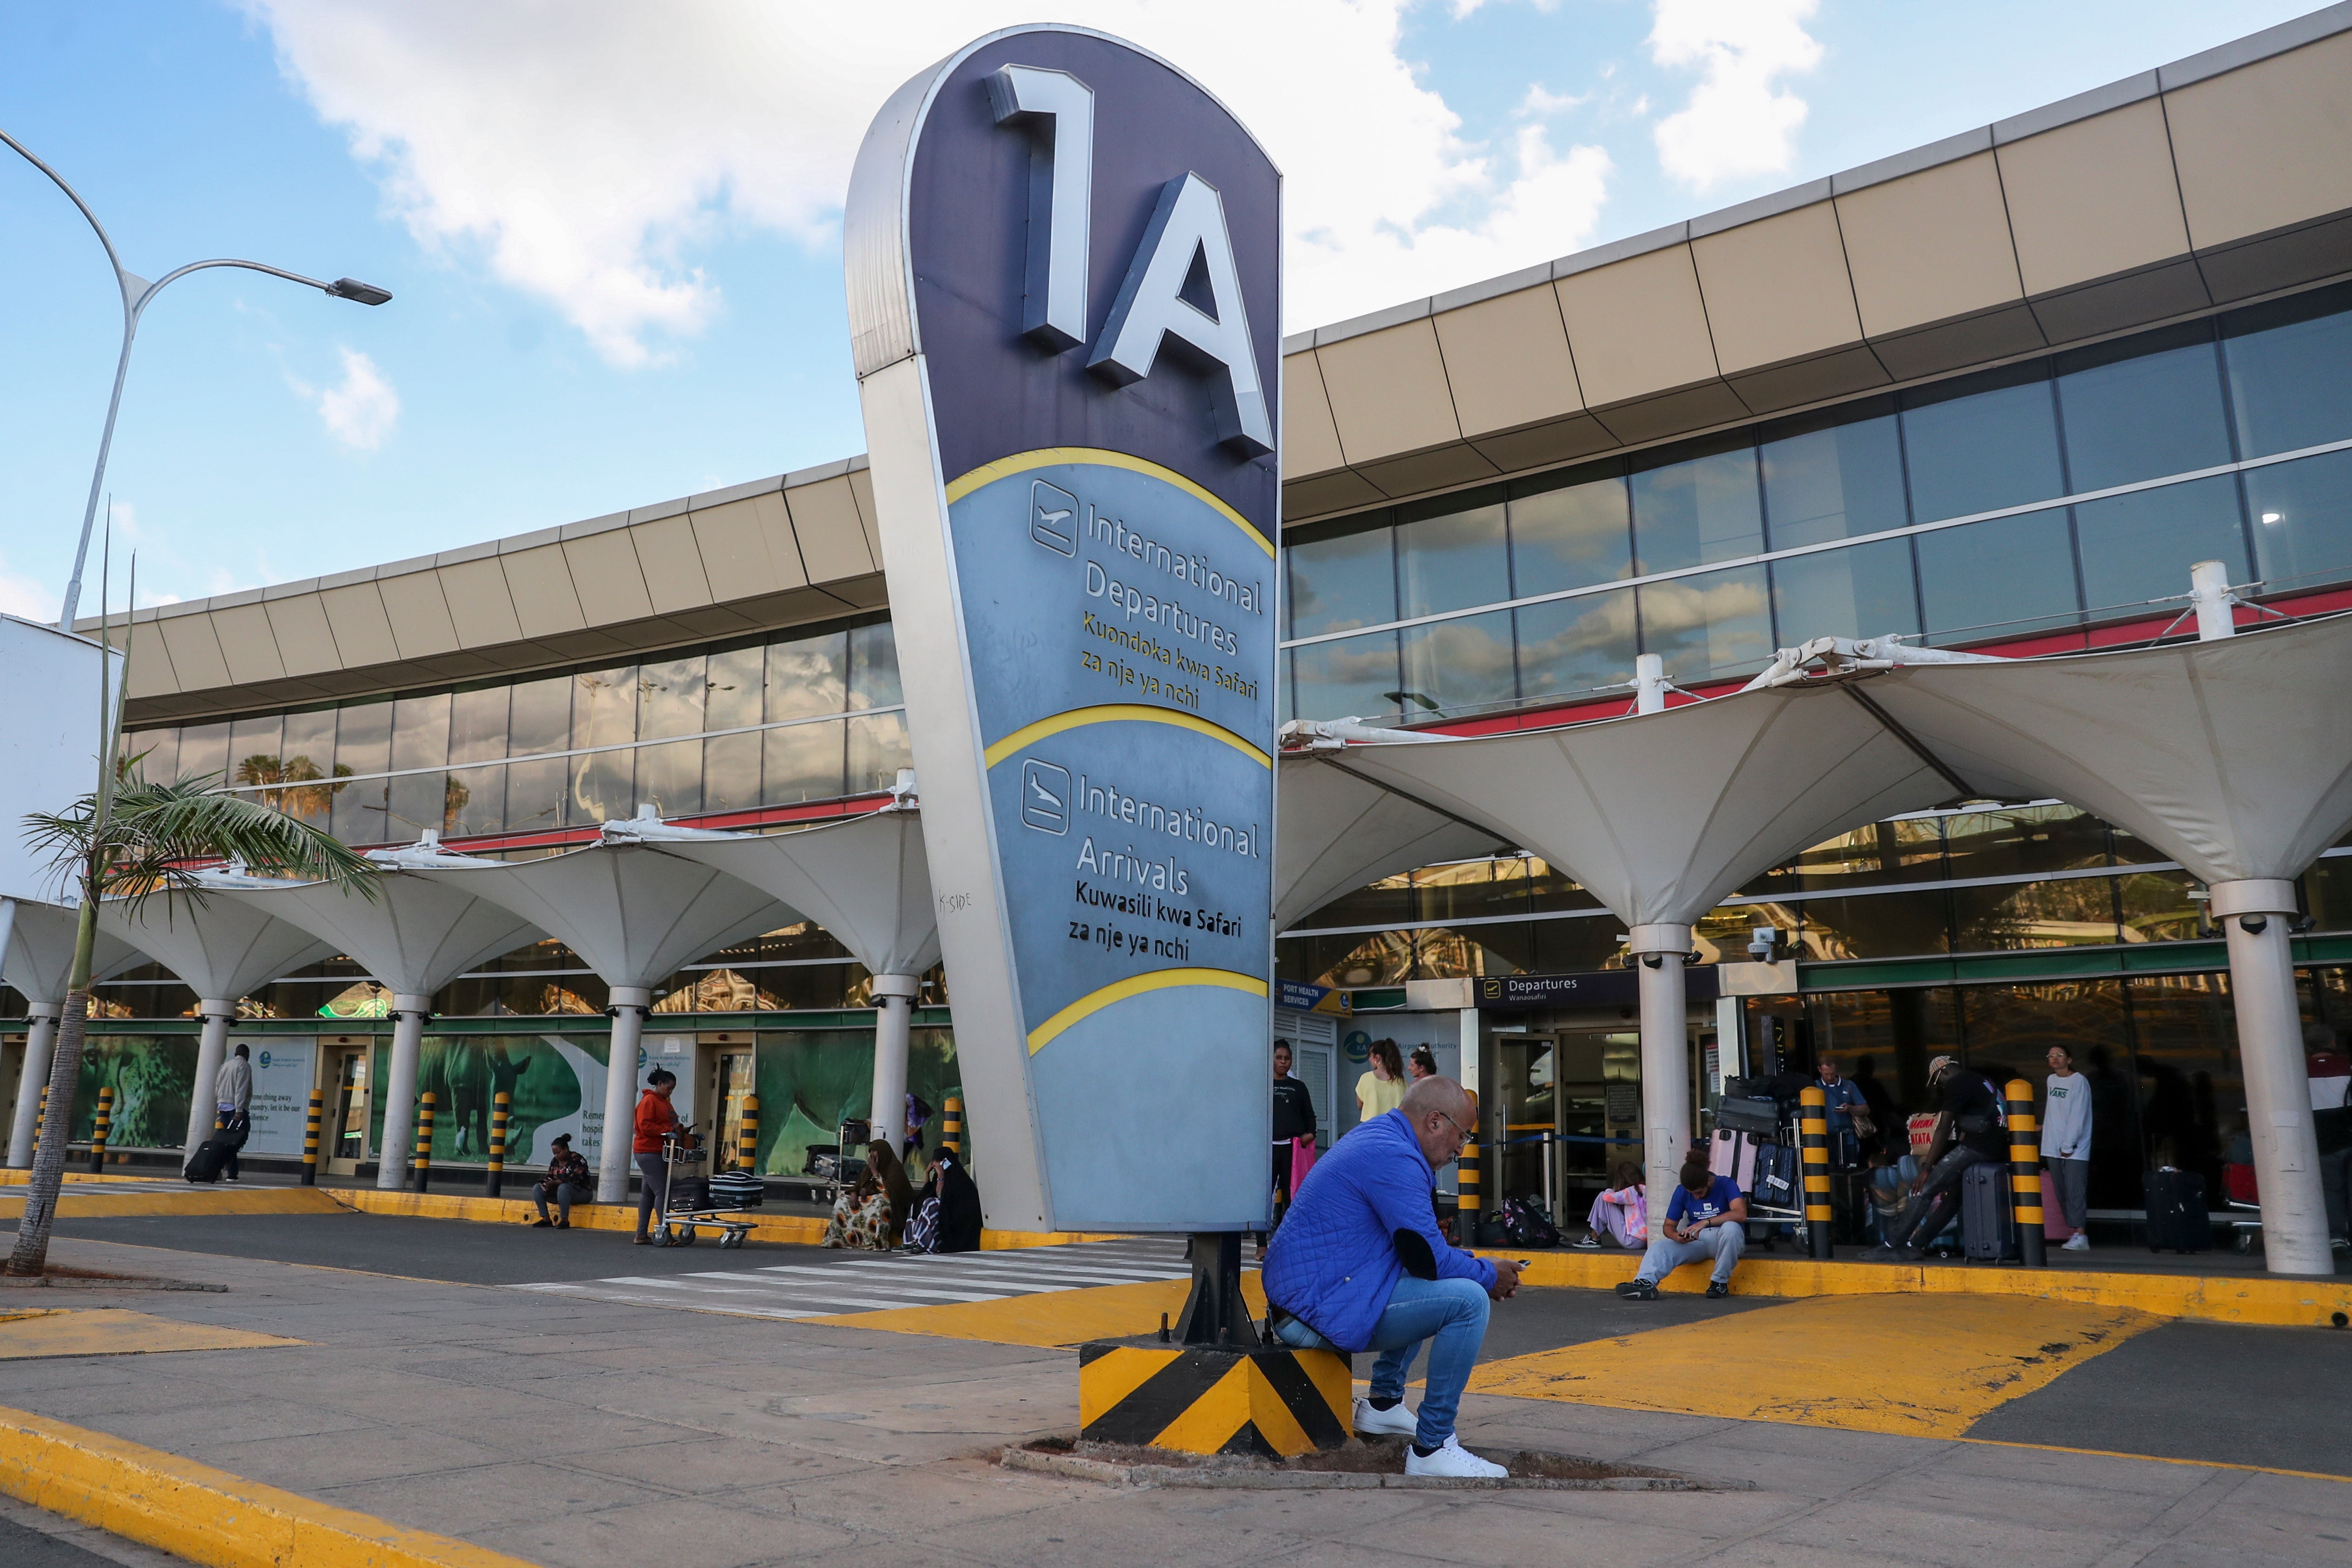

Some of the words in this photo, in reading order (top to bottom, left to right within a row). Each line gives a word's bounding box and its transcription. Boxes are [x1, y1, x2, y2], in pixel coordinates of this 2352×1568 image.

[983, 63, 1275, 459] 1A
[1089, 503, 1262, 615] International
[1087, 560, 1238, 656] Departures
[1082, 651, 1101, 672] za
[1108, 659, 1134, 687] nje
[1140, 673, 1159, 695] ya
[1166, 684, 1199, 709] nchi
[1084, 611, 1171, 665] Kuondoka
[1177, 648, 1209, 680] kwa
[1215, 666, 1257, 700] Safari
[1080, 774, 1259, 859] International
[1076, 836, 1188, 896] Arrivals
[1076, 880, 1151, 918] Kuwasili
[1157, 898, 1191, 926] kwa
[1197, 909, 1241, 937] Safari
[1069, 921, 1089, 941] za
[1096, 922, 1123, 952] nje
[1129, 933, 1148, 957] ya
[1154, 937, 1189, 961] nchi
[1284, 984, 1298, 994] PORT
[1299, 986, 1318, 997] HEALTH
[1284, 995, 1309, 1006] SERVICES
[1509, 979, 1577, 993] Departures
[2049, 1087, 2068, 1098] VANS
[582, 1137, 600, 1147] takes
